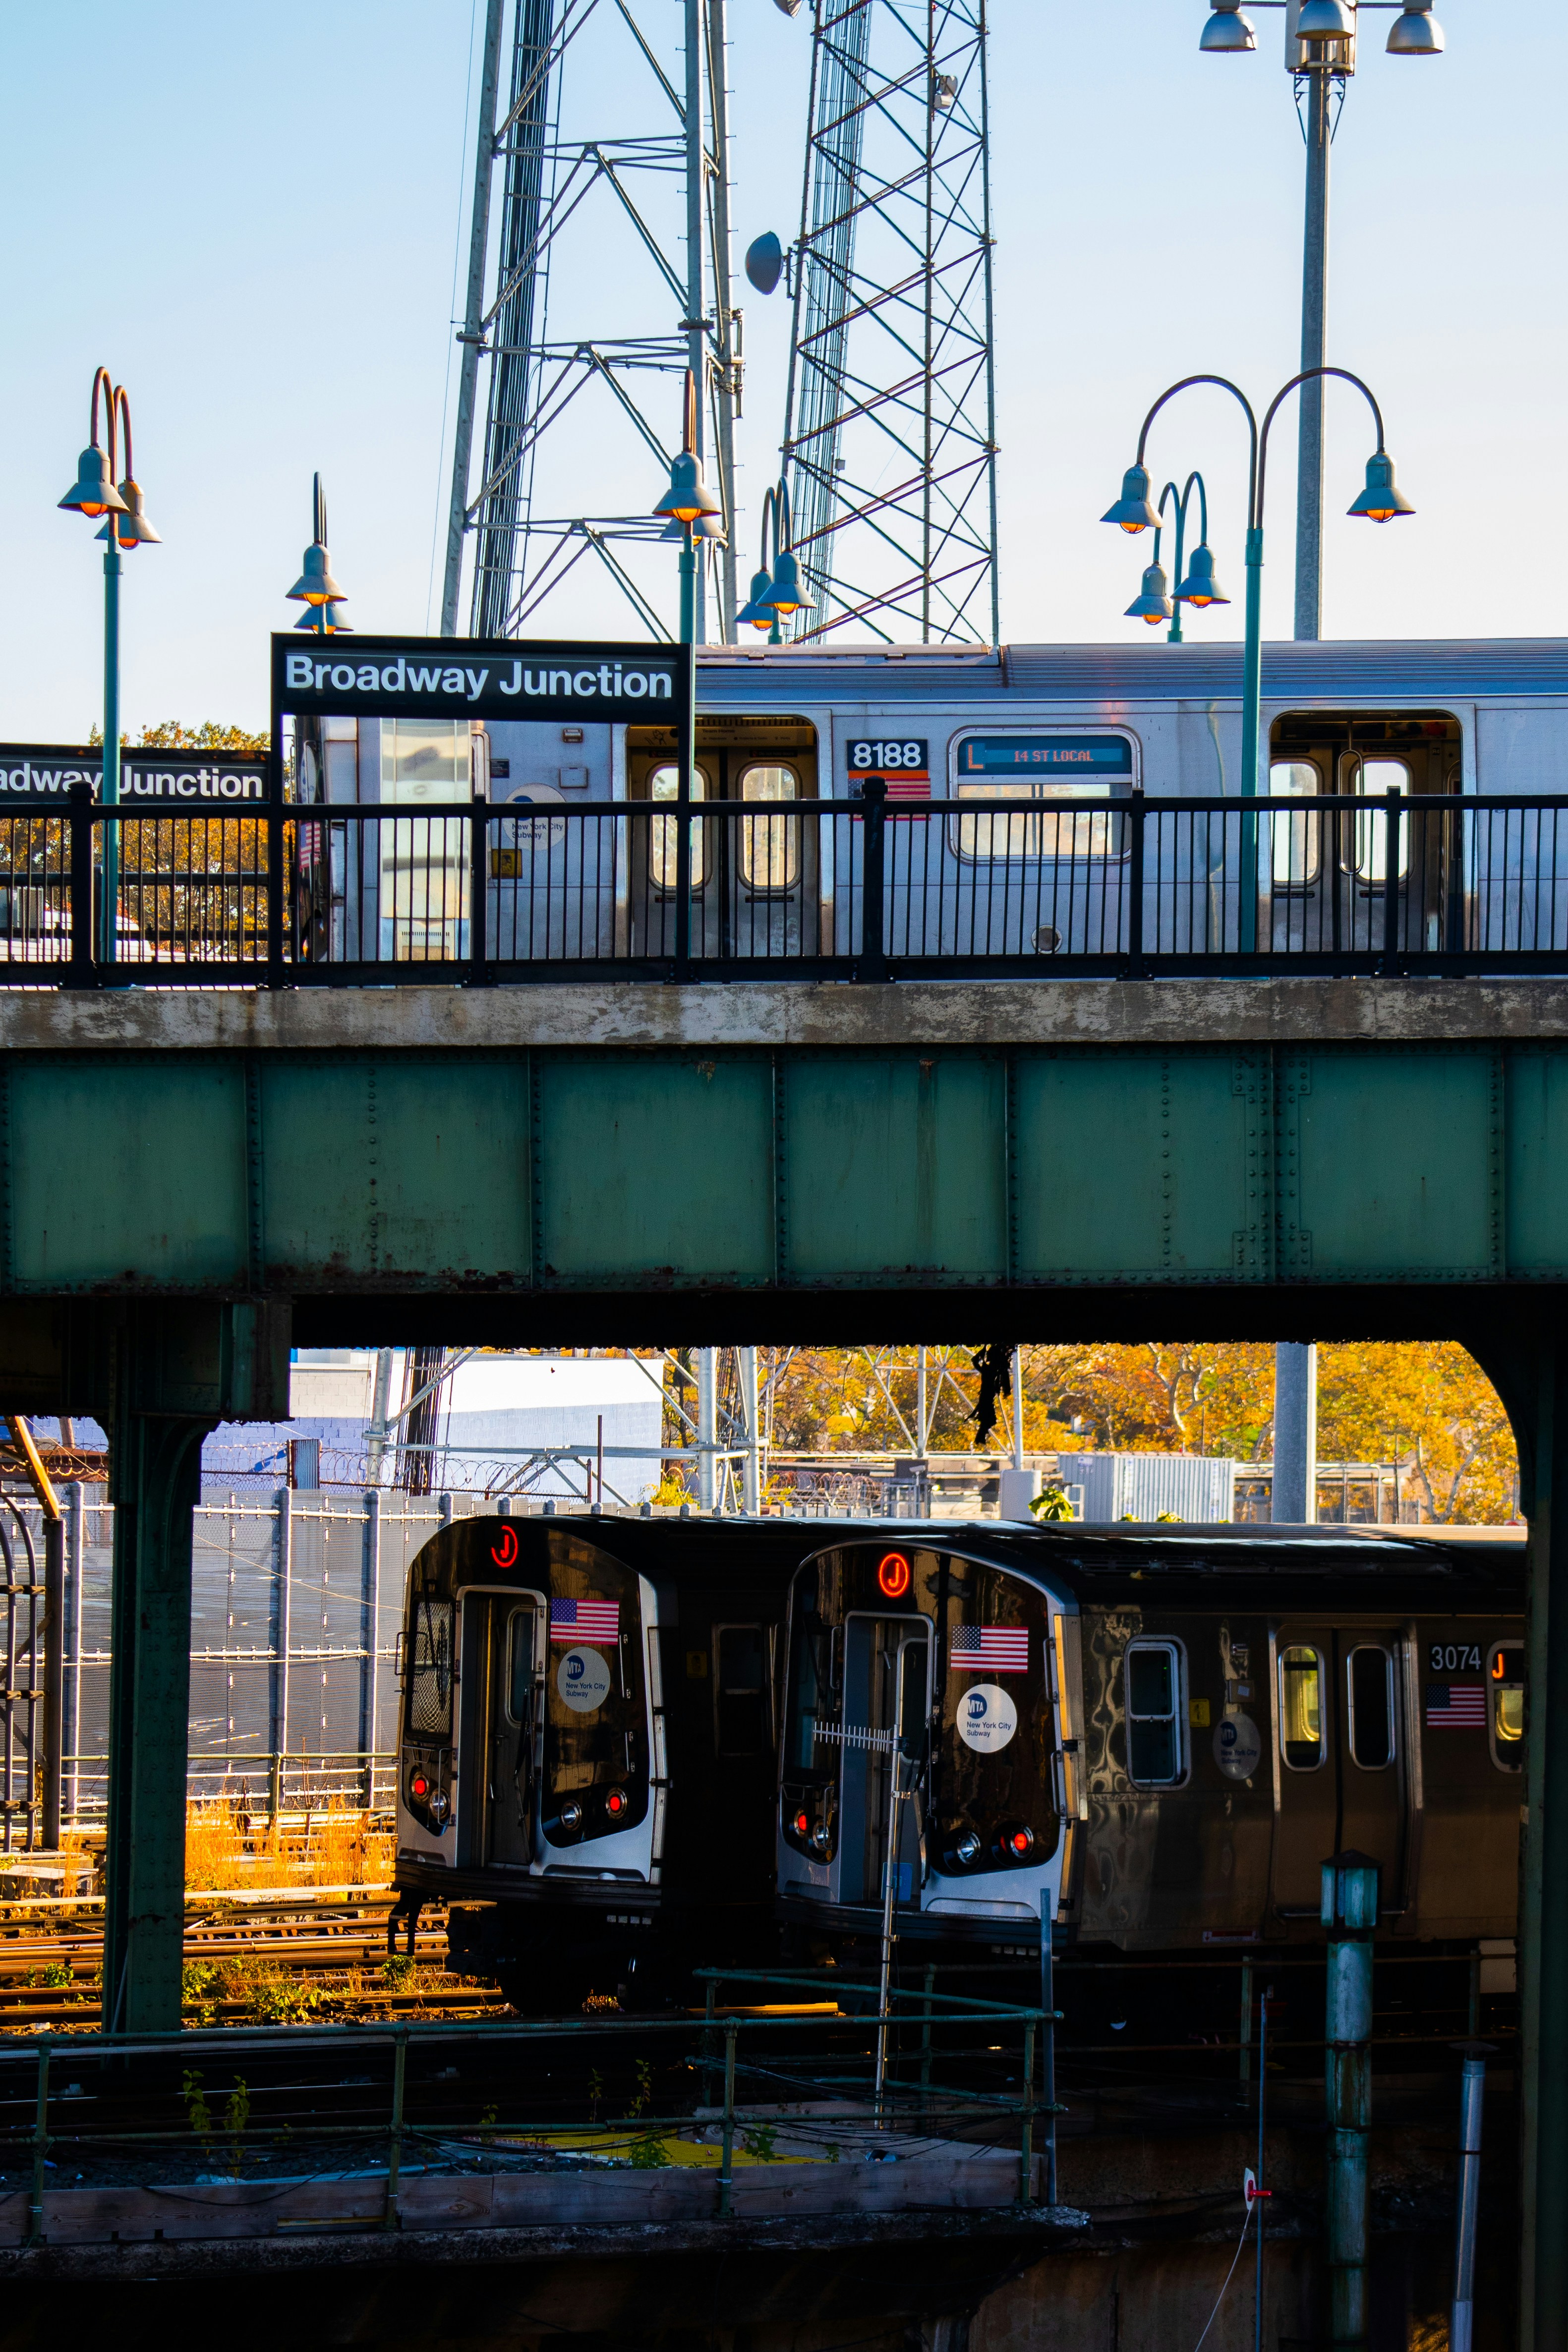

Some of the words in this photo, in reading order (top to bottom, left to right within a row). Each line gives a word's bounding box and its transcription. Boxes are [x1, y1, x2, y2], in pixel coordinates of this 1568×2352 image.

[286, 655, 489, 701] Broadway
[500, 662, 672, 697] Junction
[854, 743, 921, 768] 8188
[968, 745, 984, 769] L
[1015, 750, 1028, 762] 14
[1032, 750, 1049, 762] ST
[1053, 750, 1094, 762] LOCAL
[119, 766, 262, 797] Junction
[500, 1535, 509, 1558] J
[888, 1562, 900, 1588] J
[567, 1661, 581, 1674] MTA
[1432, 1646, 1481, 1669] 3074
[1492, 1653, 1504, 1678] J
[967, 1698, 984, 1713] MTA
